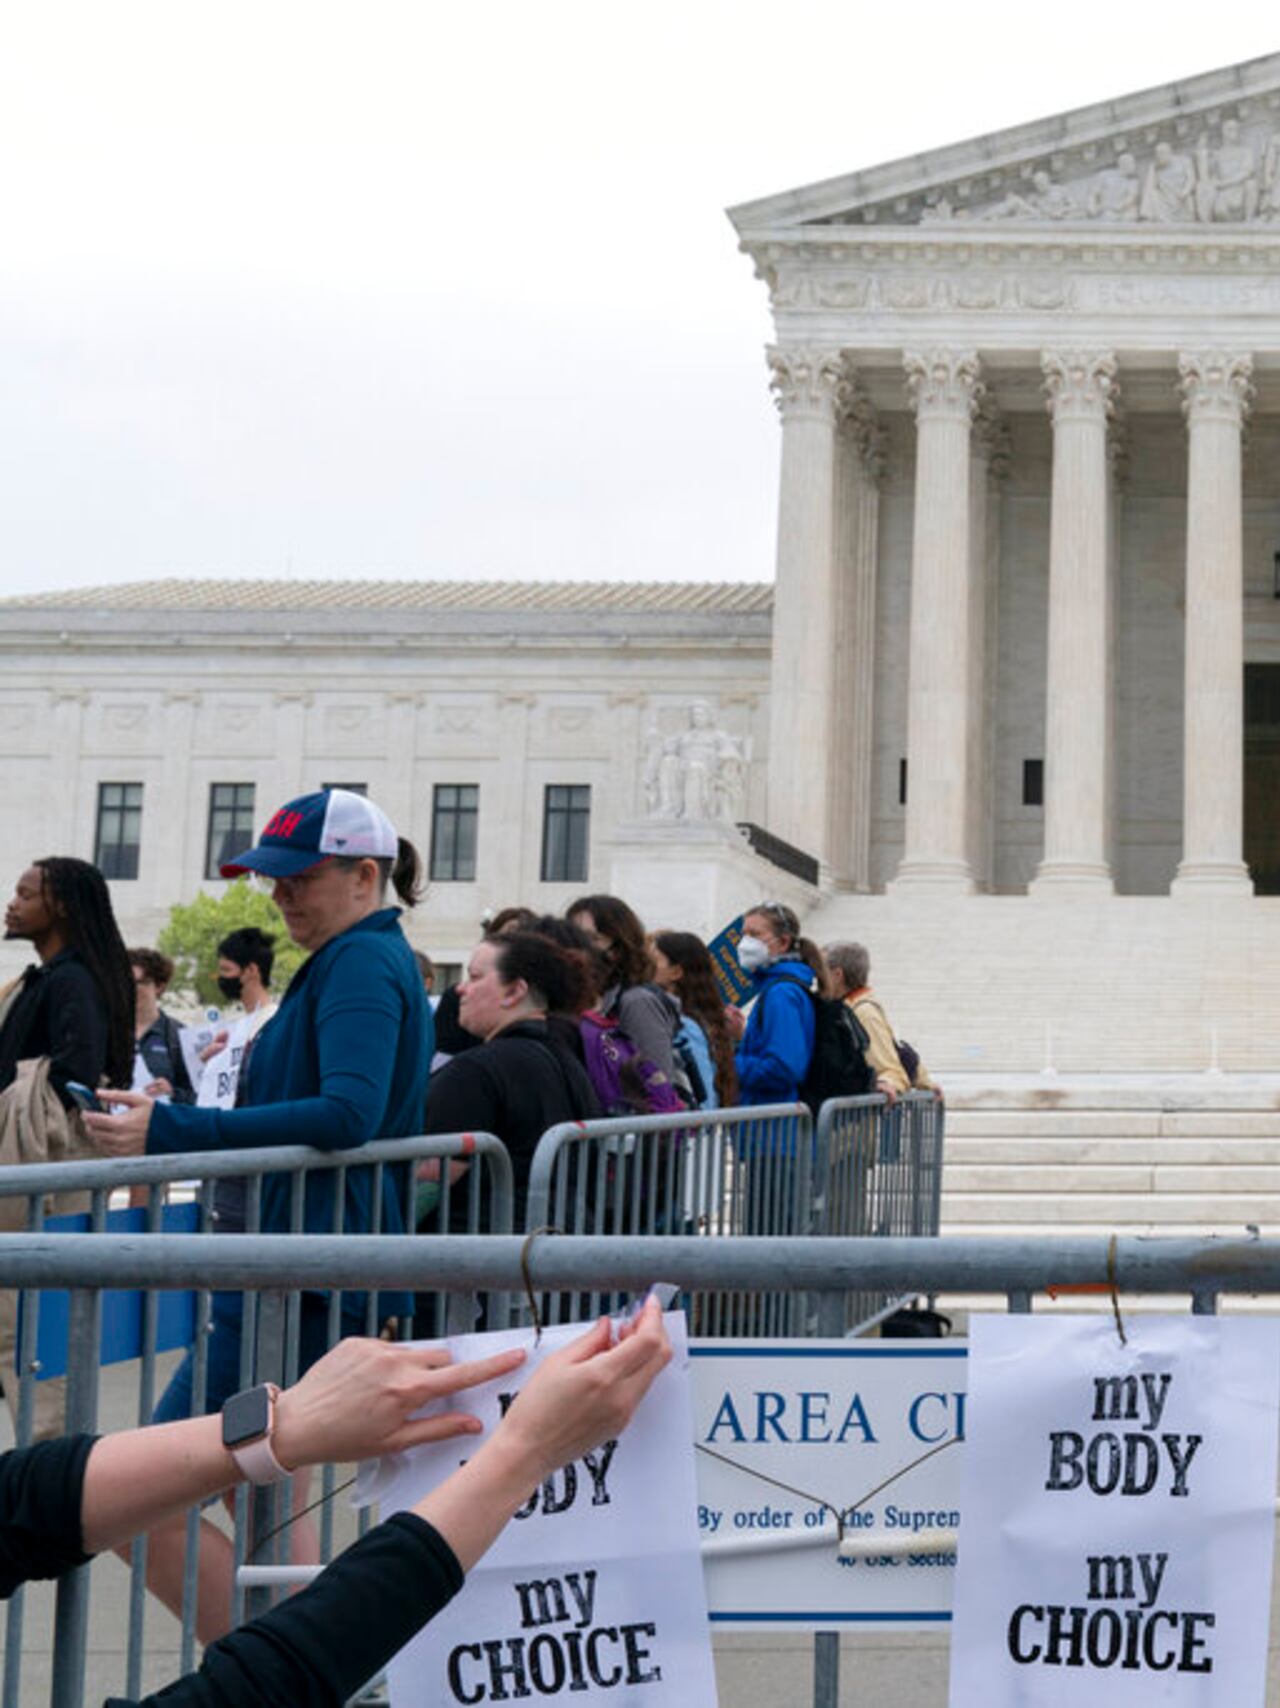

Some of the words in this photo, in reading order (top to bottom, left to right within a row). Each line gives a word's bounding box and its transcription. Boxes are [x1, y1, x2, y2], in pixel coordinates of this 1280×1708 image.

[705, 1391, 878, 1443] AREA
[1091, 1372, 1172, 1431] my
[513, 1439, 619, 1520] DY
[1045, 1431, 1203, 1496] BODY
[698, 1505, 723, 1532] By
[733, 1505, 793, 1527] order
[804, 1505, 829, 1527] of
[841, 1507, 874, 1528] the
[514, 1569, 597, 1629] my
[1086, 1553, 1169, 1609] my
[447, 1621, 663, 1706] CHOICE
[1007, 1604, 1216, 1673] CHOICE
